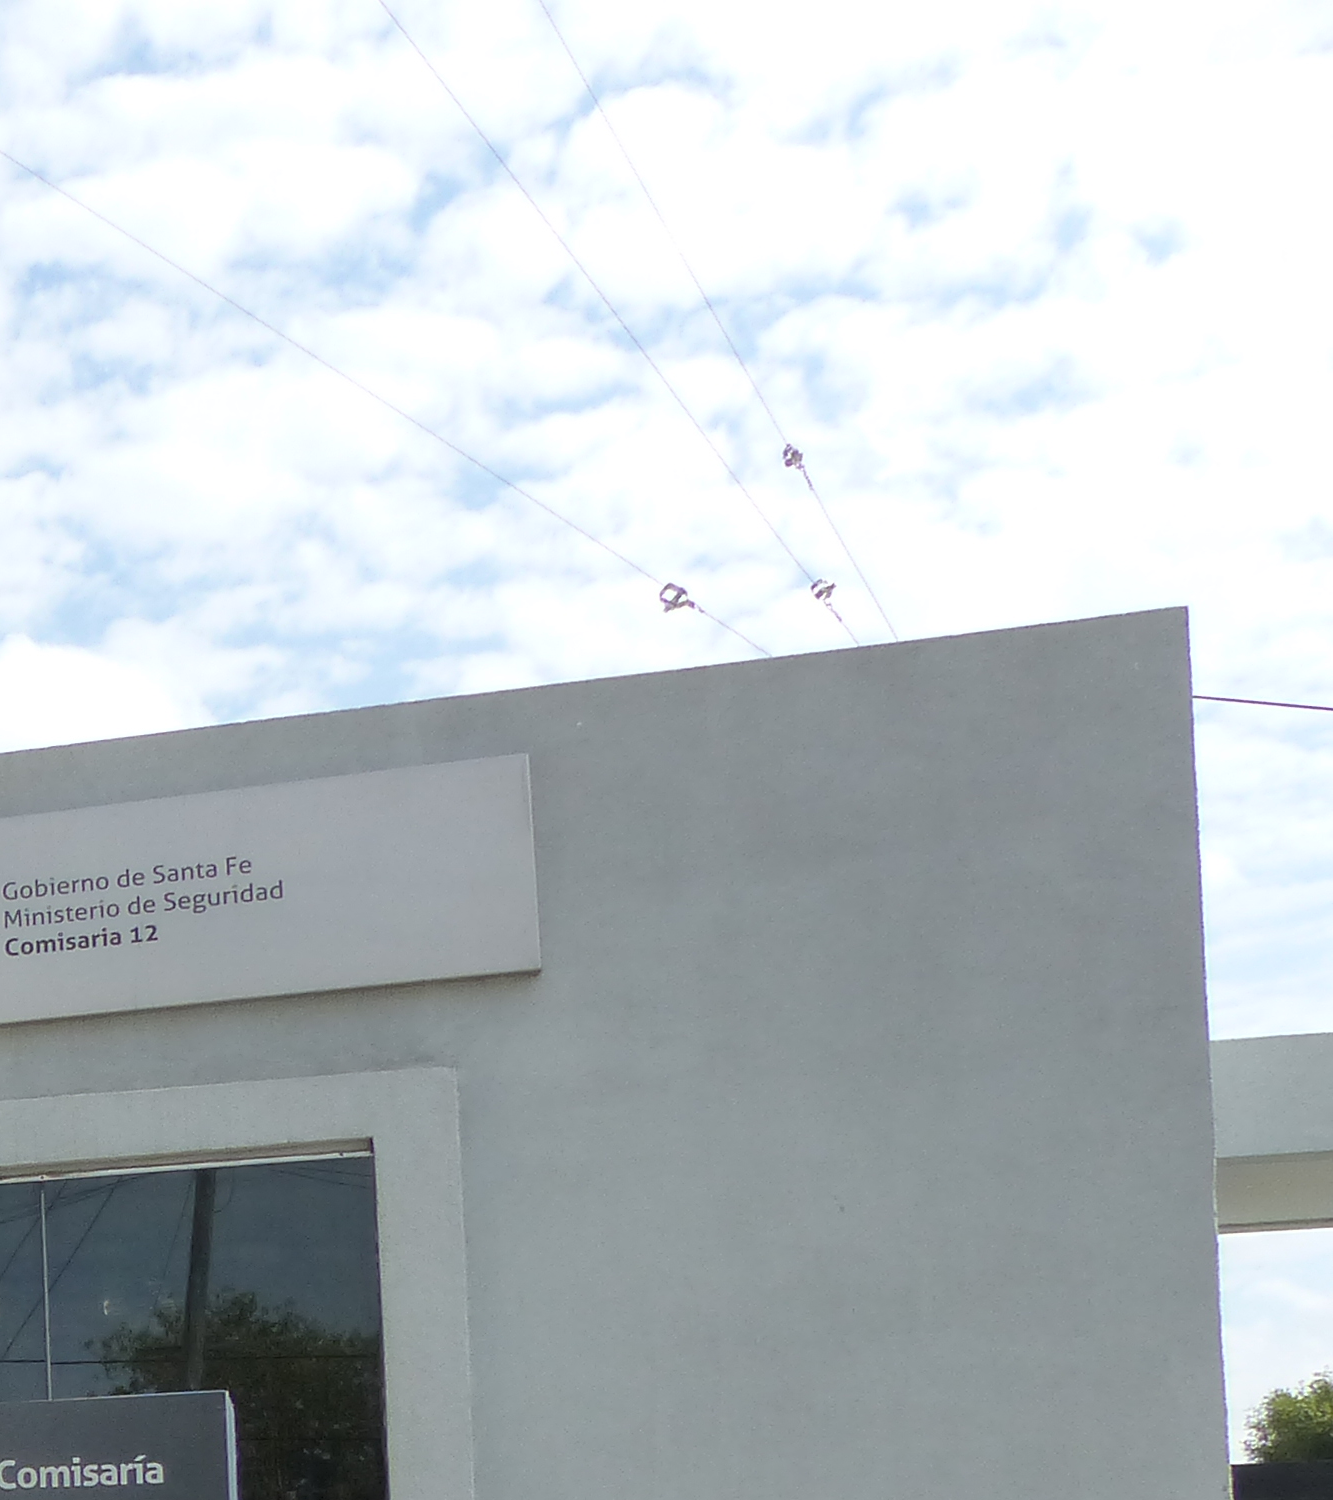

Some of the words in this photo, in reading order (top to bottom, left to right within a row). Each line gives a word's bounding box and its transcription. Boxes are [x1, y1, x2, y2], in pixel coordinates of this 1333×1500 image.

[2, 877, 109, 901] Gobierno
[116, 869, 145, 888] de
[152, 861, 218, 885] Santa
[225, 856, 252, 876] Fe
[4, 899, 120, 929] Ministerio
[127, 895, 156, 915] de
[163, 880, 284, 914] Seguridad
[4, 927, 122, 957] Comisaria
[130, 924, 159, 944] 12
